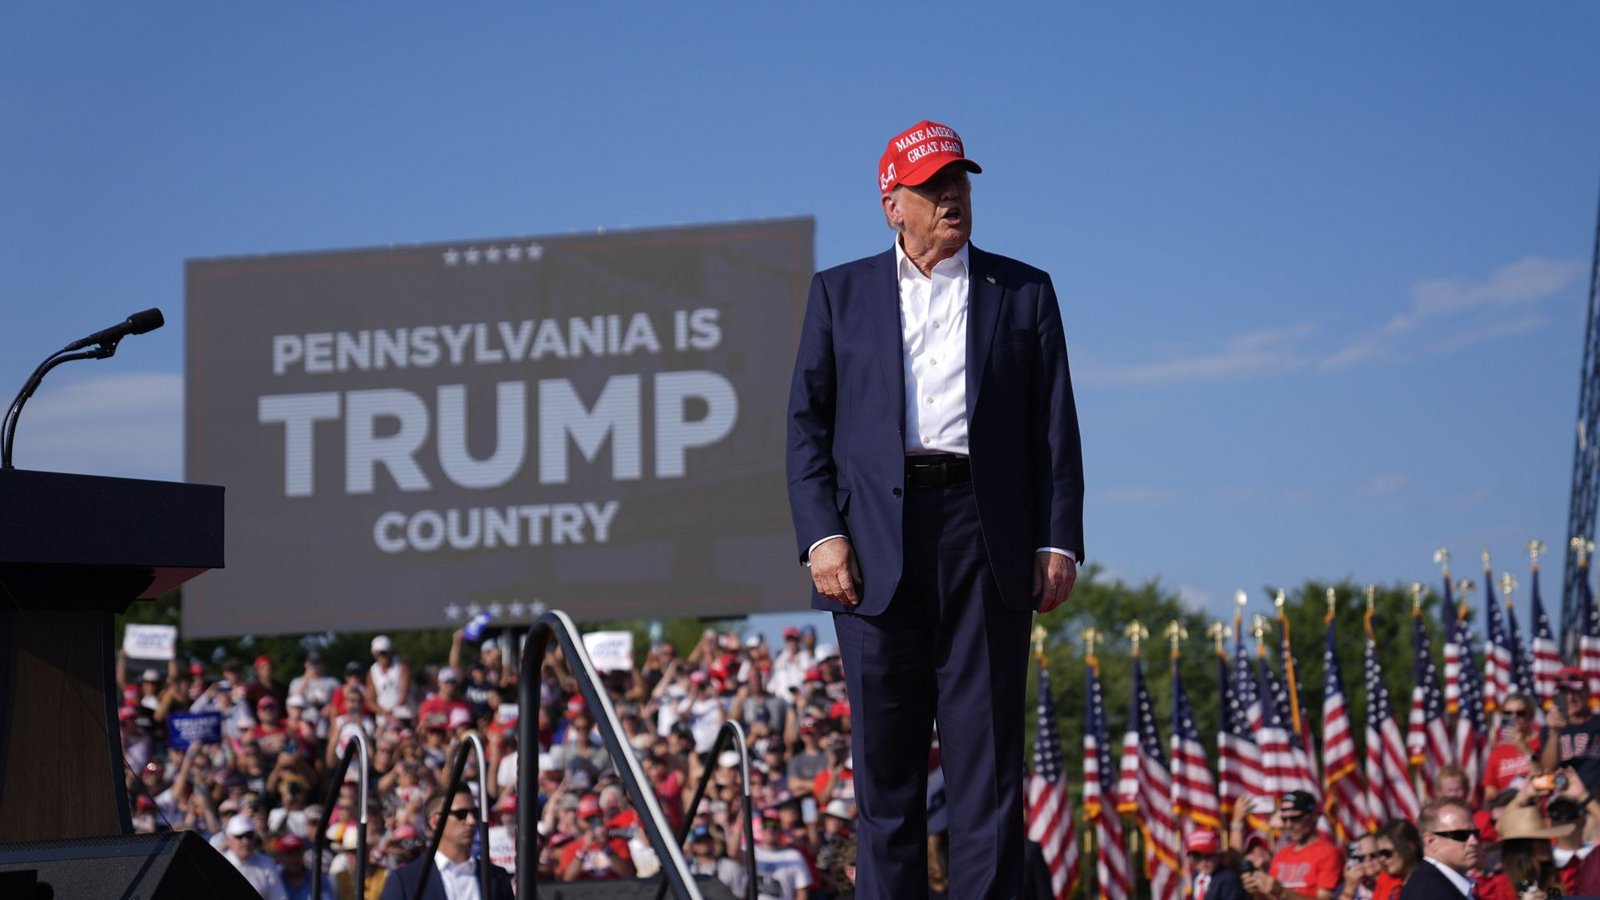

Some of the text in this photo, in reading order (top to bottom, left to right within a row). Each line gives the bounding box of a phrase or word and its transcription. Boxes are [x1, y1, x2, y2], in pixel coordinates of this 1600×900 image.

[895, 126, 961, 153] MAKE AMERIC
[907, 141, 939, 163] GREAT
[273, 308, 721, 374] PENNSYLVANIA IS
[259, 370, 738, 497] TRUMP
[373, 501, 618, 553] COUNTRY
